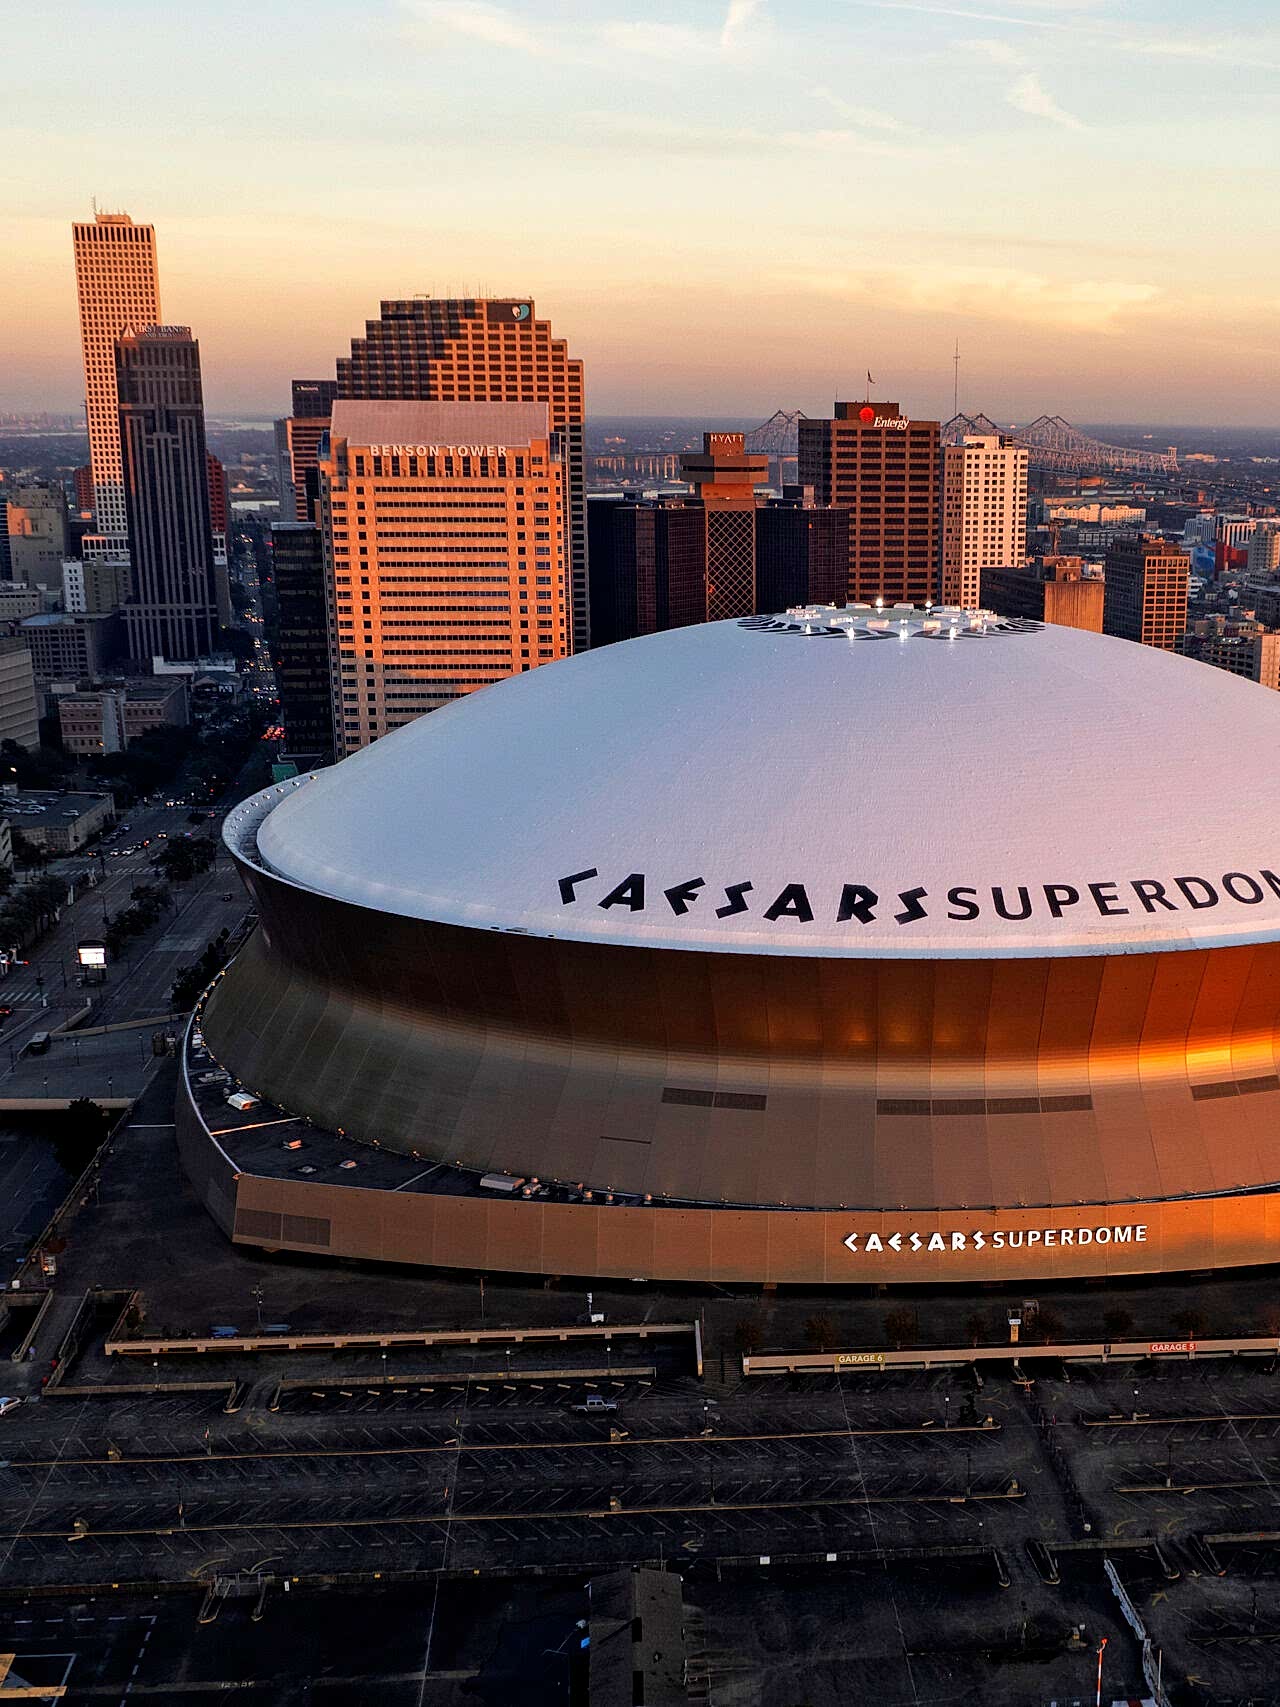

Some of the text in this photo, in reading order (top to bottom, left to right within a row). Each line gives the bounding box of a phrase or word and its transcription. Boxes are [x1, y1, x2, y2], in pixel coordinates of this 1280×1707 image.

[160, 325, 183, 333] BANK
[873, 416, 910, 431] Entergy
[710, 434, 744, 444] HYATT
[369, 445, 507, 457] BENSON TOWER
[557, 867, 929, 925] CAESARS
[843, 1225, 1148, 1253] CAESARS SUPERDOME
[1151, 1343, 1187, 1351] GARAGE
[838, 1354, 883, 1363] GARAGE 6
